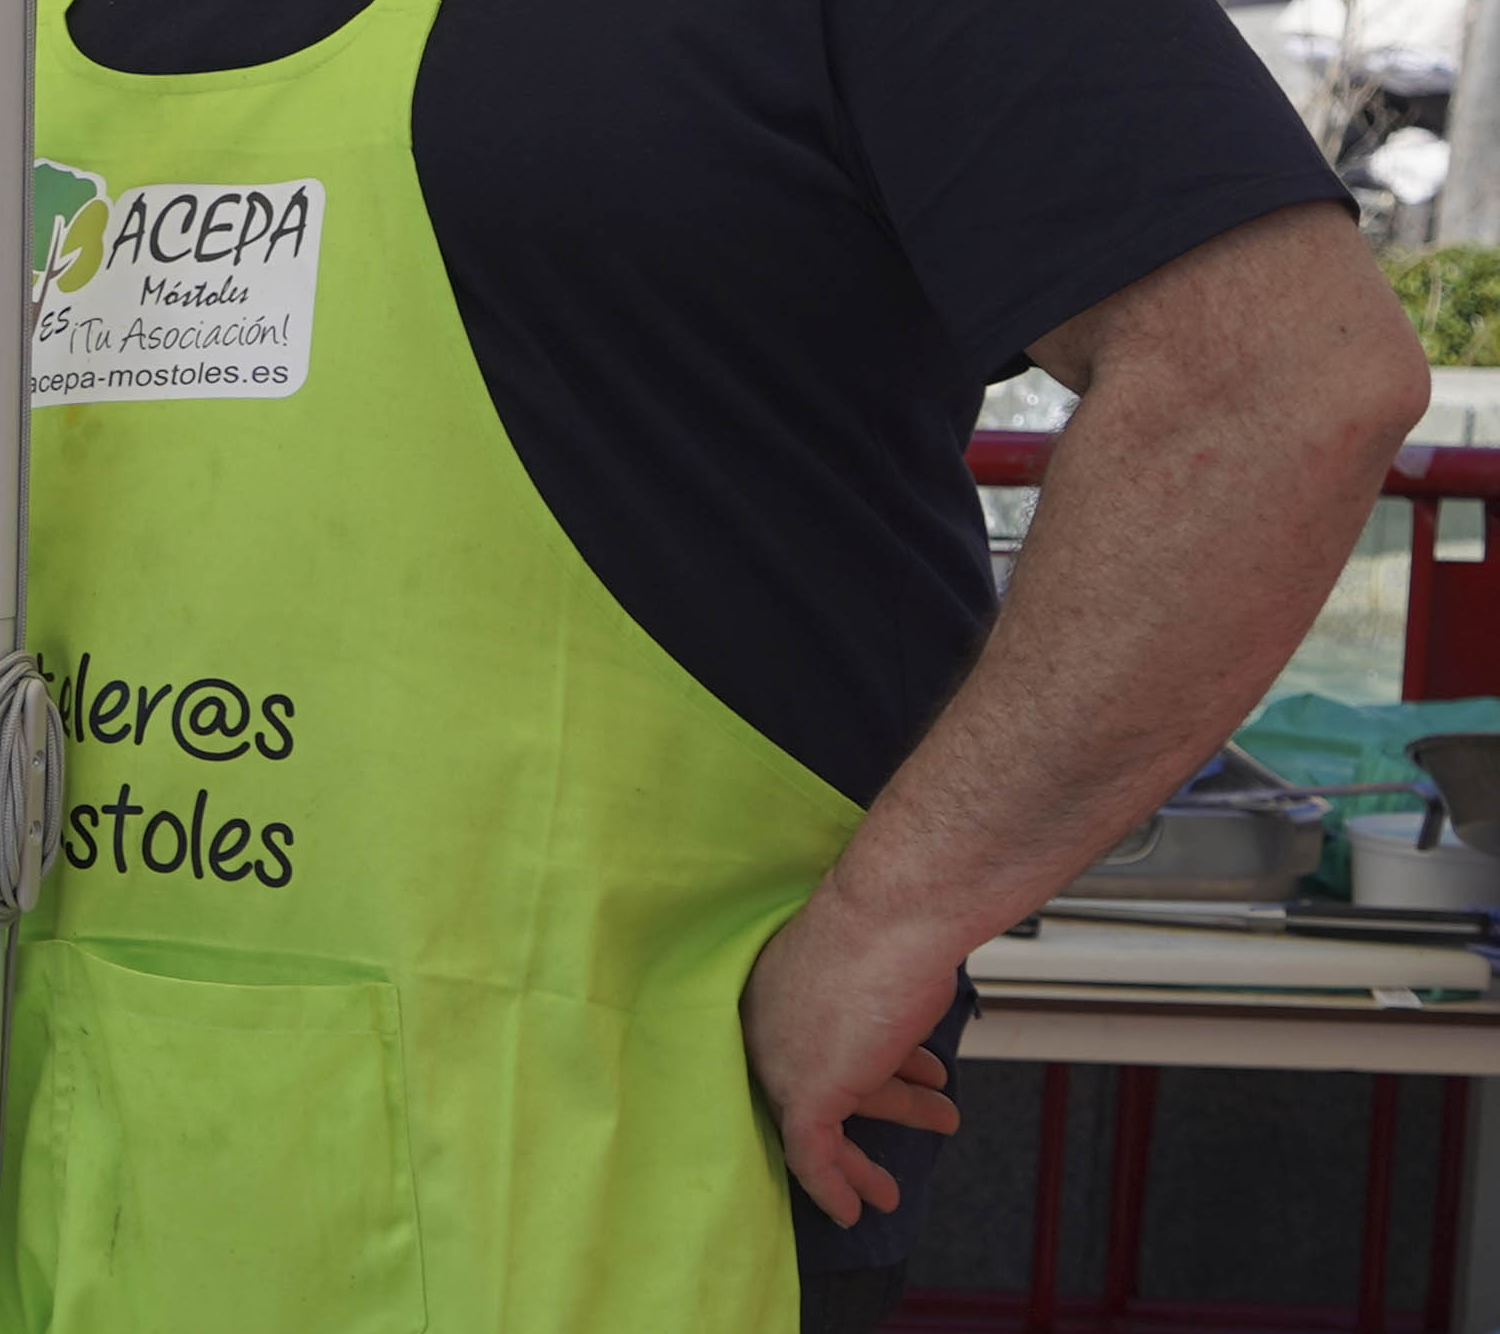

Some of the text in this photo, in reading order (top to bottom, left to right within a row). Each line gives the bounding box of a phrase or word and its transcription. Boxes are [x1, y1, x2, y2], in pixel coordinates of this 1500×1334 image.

[106, 185, 308, 270] ACEPA
[140, 275, 249, 307] Móstoles
[39, 307, 71, 342] ES
[119, 313, 290, 354] Asociación!
[60, 783, 294, 889] stoles
